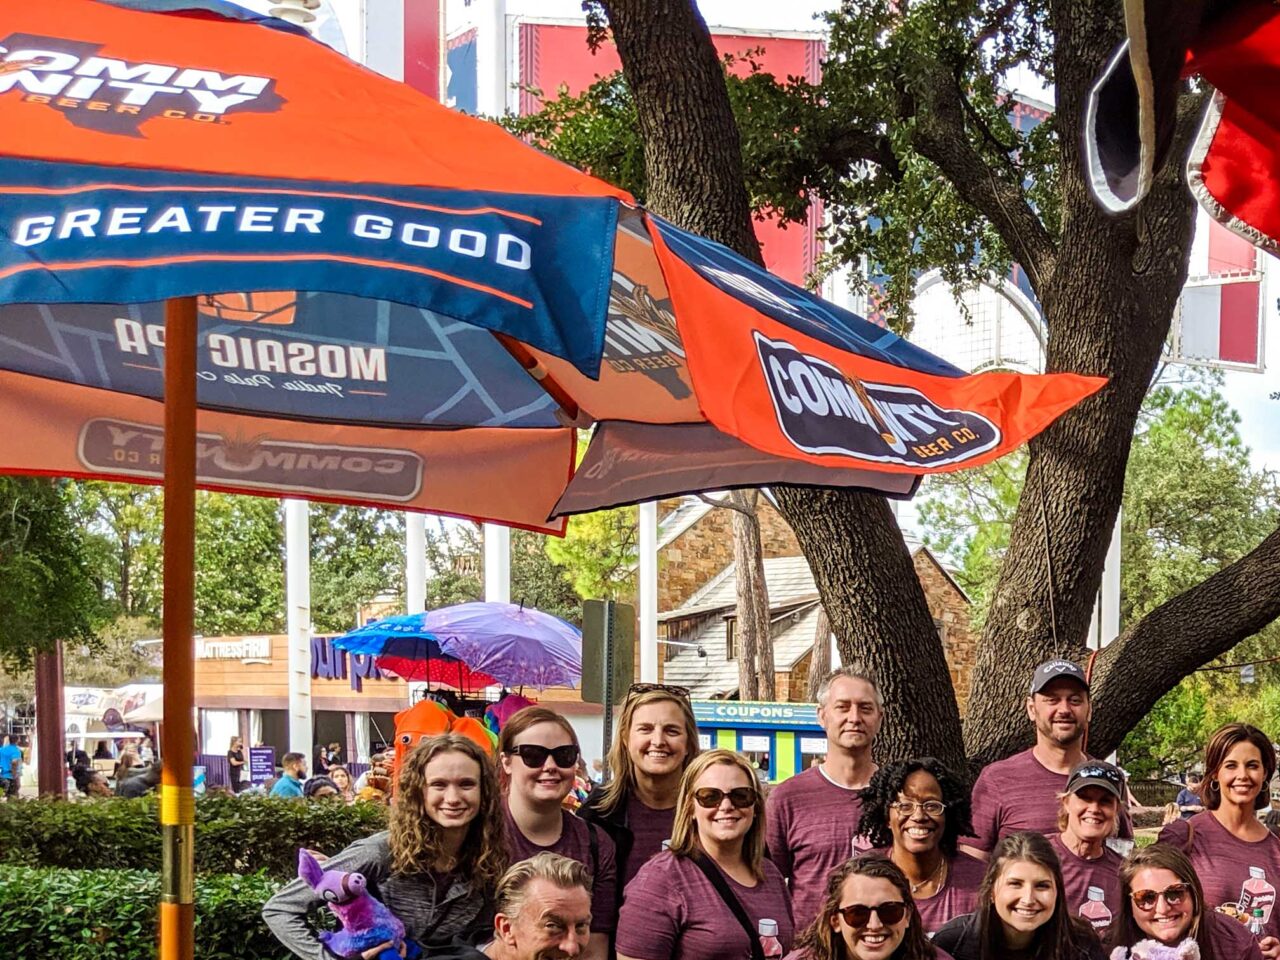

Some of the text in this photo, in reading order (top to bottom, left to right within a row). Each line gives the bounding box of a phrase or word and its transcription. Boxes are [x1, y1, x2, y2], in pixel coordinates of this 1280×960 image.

[25, 95, 142, 116] BEER
[15, 206, 533, 271] GREATER GOOD
[912, 437, 954, 459] BEER
[1043, 660, 1078, 674] Callaway
[715, 705, 794, 718] COUPONS
